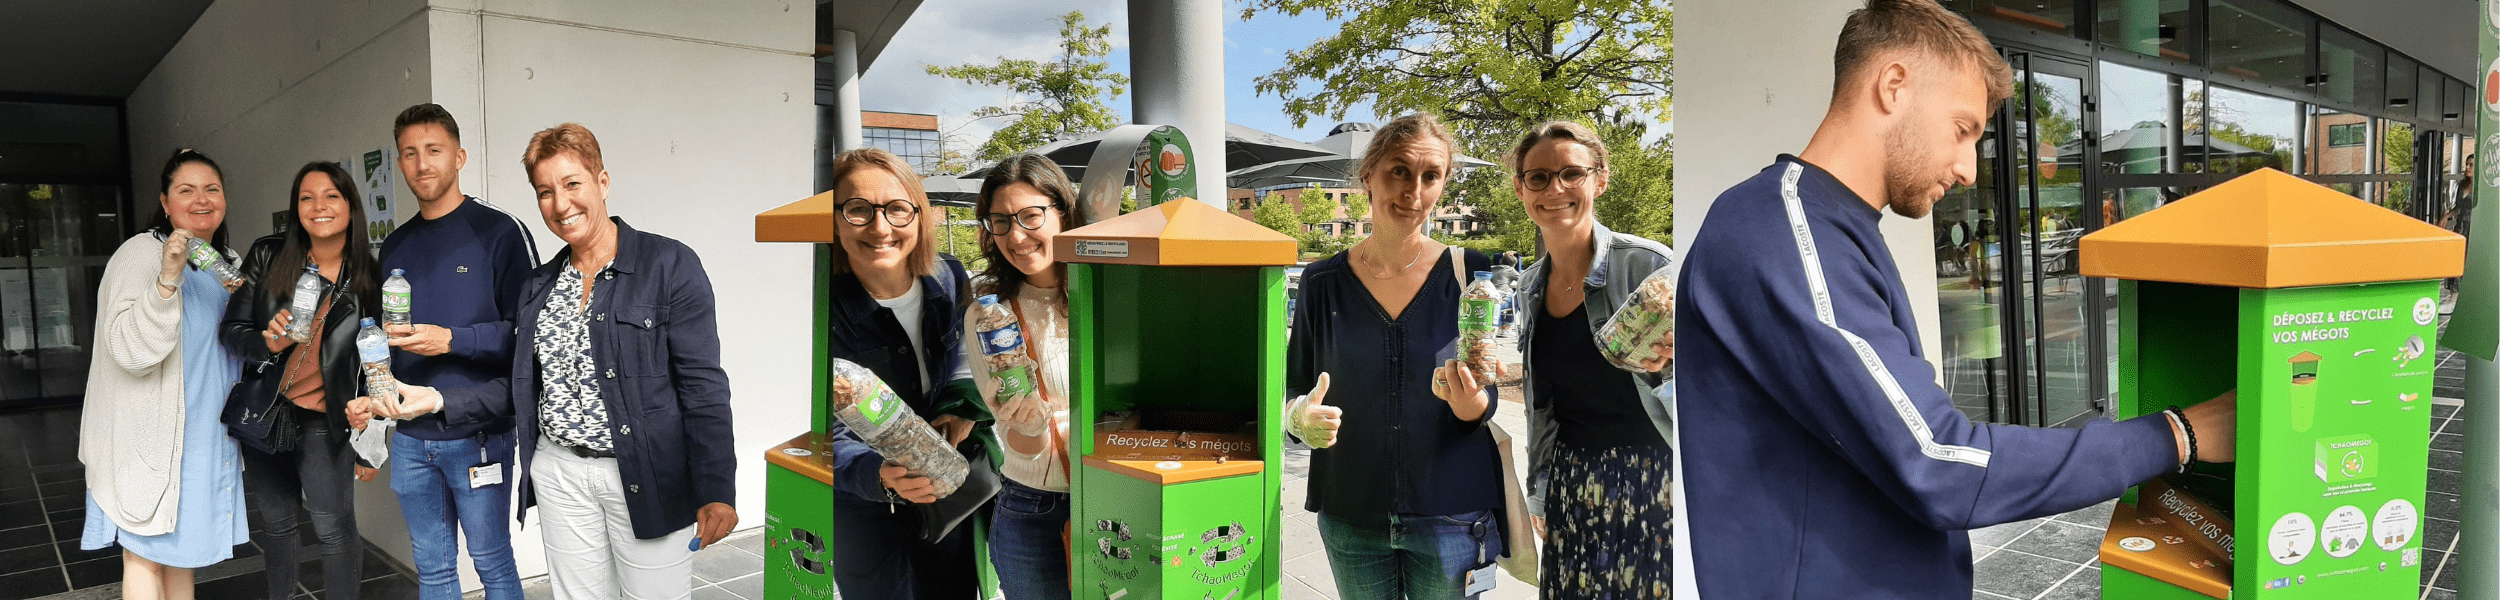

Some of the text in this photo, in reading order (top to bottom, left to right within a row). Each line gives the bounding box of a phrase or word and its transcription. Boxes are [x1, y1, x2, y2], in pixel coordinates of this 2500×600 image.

[1796, 224, 1812, 256] LACOSTE
[2273, 308, 2394, 327] DÉPOSEZ & RECYCLEZ
[2273, 326, 2350, 344] VOS MÉGOTS
[1855, 340, 1880, 372] LACOSTE
[1897, 398, 1922, 431] LACOSTE
[1106, 434, 1169, 449] Recyclez
[1201, 438, 1251, 453] mégots
[2330, 439, 2372, 450] TCHAOMEGOT
[2158, 488, 2204, 526] Recyclez
[2199, 520, 2222, 540] vos
[783, 561, 832, 598] TchaoMegot
[1191, 557, 1255, 586] TchaoMegot
